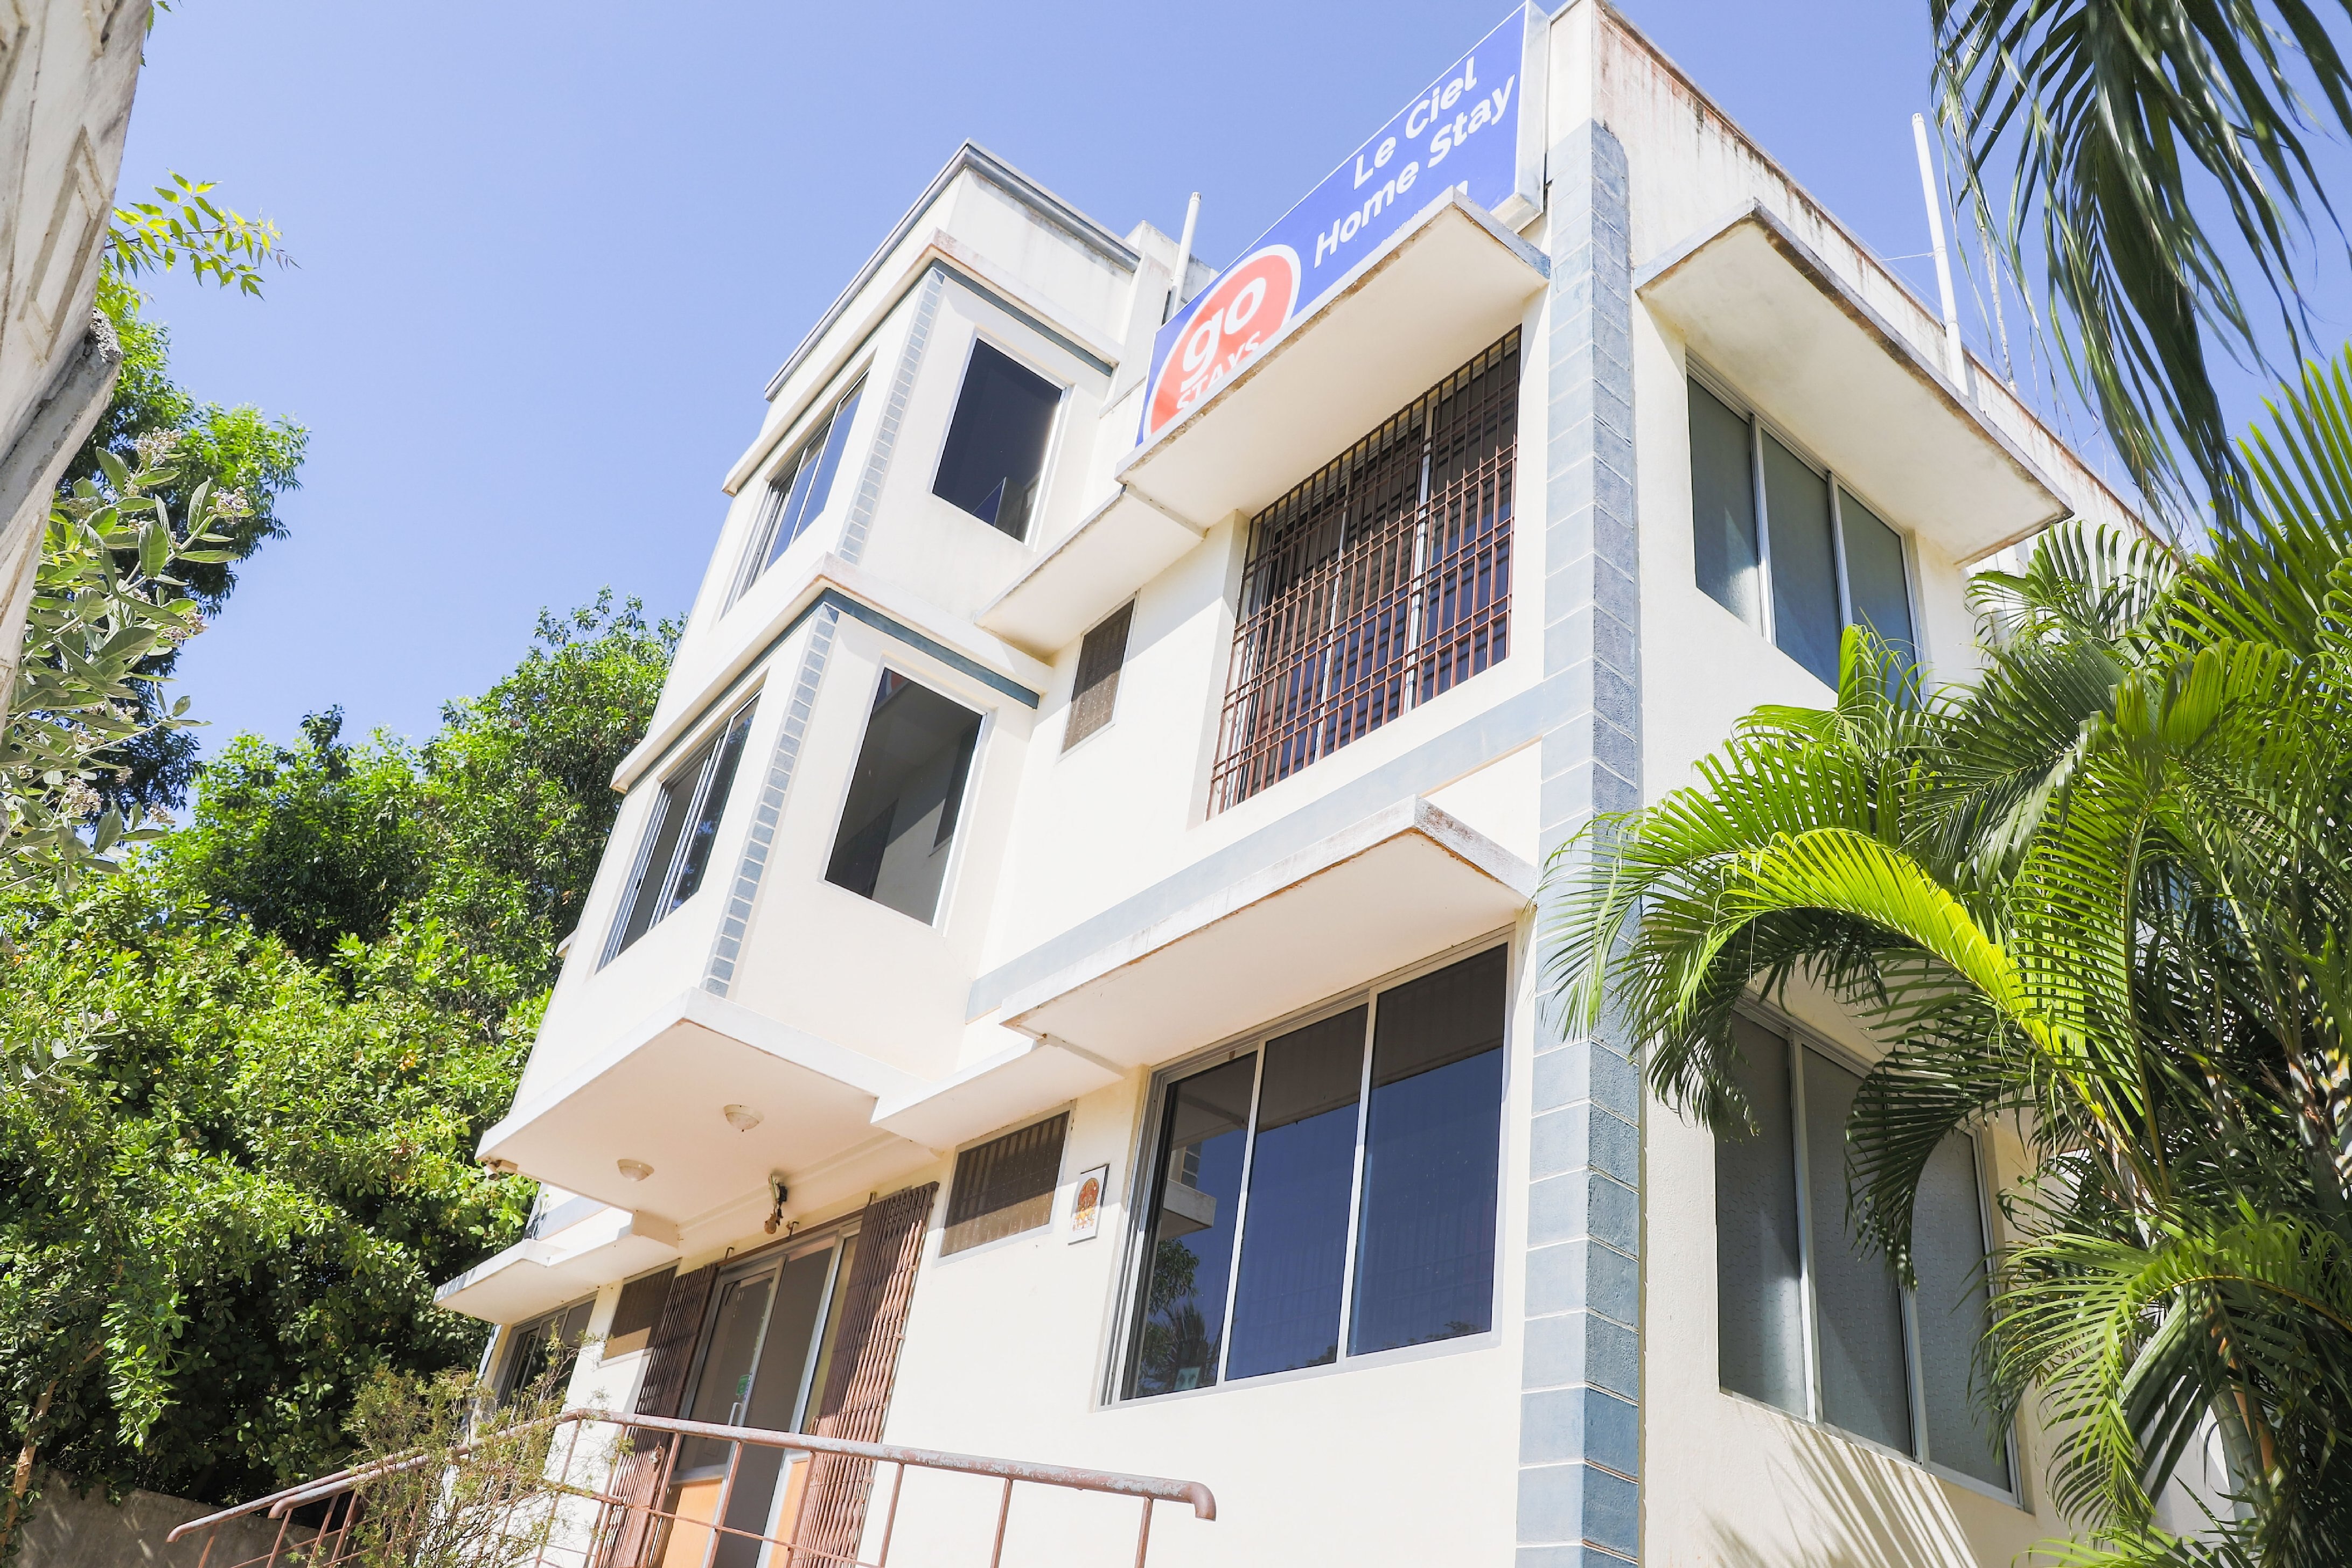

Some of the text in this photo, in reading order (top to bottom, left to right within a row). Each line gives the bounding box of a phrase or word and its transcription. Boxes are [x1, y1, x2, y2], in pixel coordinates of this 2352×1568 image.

[1314, 74, 1516, 269] Home Stay
[1353, 55, 1477, 190] Le Ciel
[1177, 331, 1260, 409] STAYS
[1181, 277, 1266, 393] go
